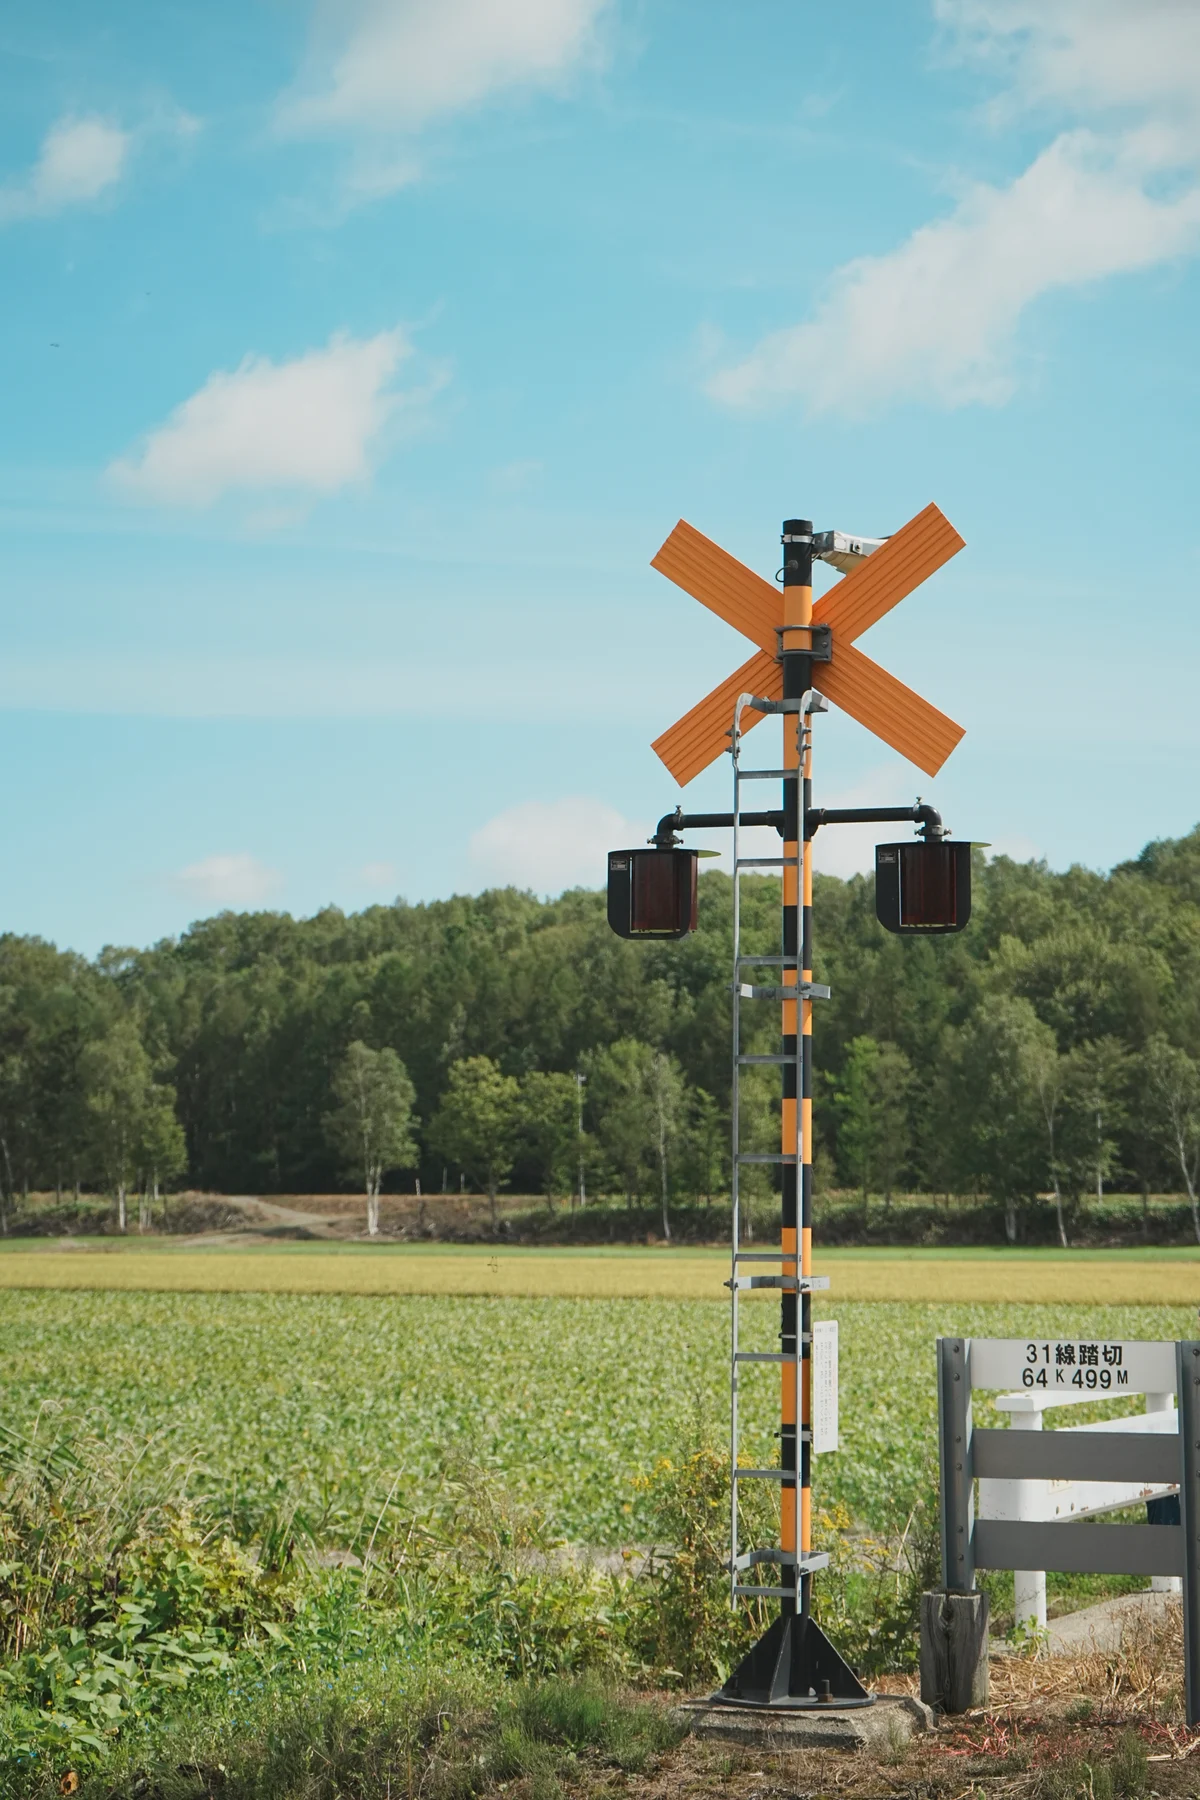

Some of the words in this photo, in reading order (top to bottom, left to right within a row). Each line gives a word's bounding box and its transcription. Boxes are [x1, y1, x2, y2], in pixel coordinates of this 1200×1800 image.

[1026, 1343, 1123, 1366] 31線踏切
[1022, 1367, 1048, 1388] 64
[1072, 1369, 1111, 1389] 499
